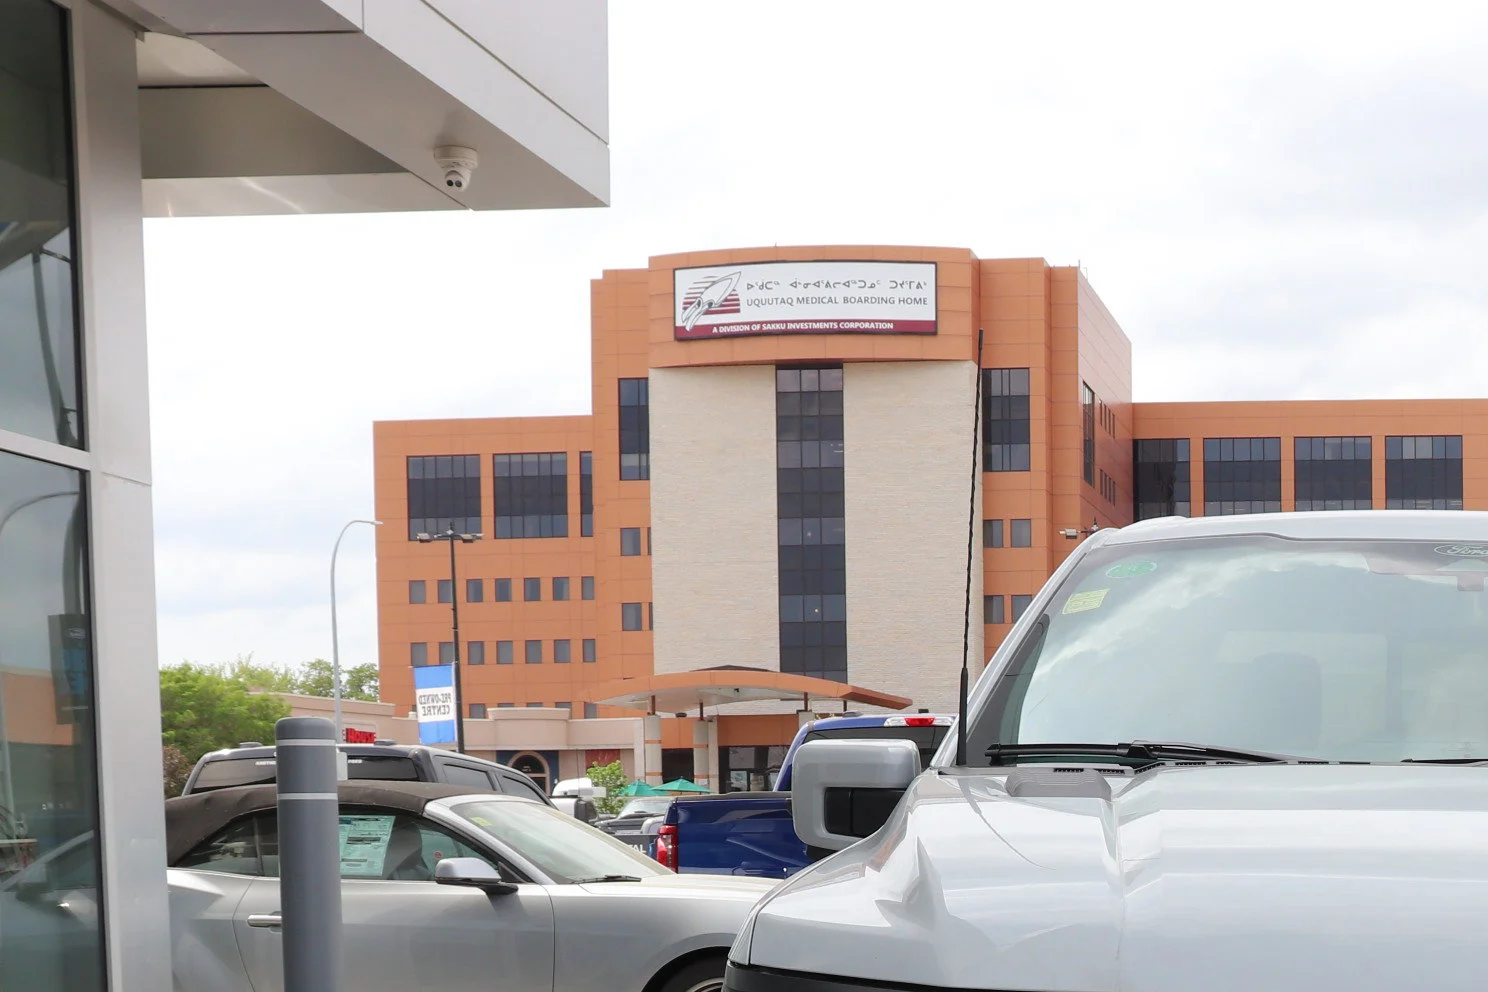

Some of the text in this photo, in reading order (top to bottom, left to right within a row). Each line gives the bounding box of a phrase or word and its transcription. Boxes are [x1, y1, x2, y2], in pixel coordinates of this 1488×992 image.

[746, 296, 928, 307] UQUUTAQ MEDICAL BOARDING HOME
[719, 325, 750, 333] DIVISION
[762, 323, 786, 331] SAKKU
[787, 322, 838, 330] INVESTMENTS
[839, 321, 894, 329] CORPORATION
